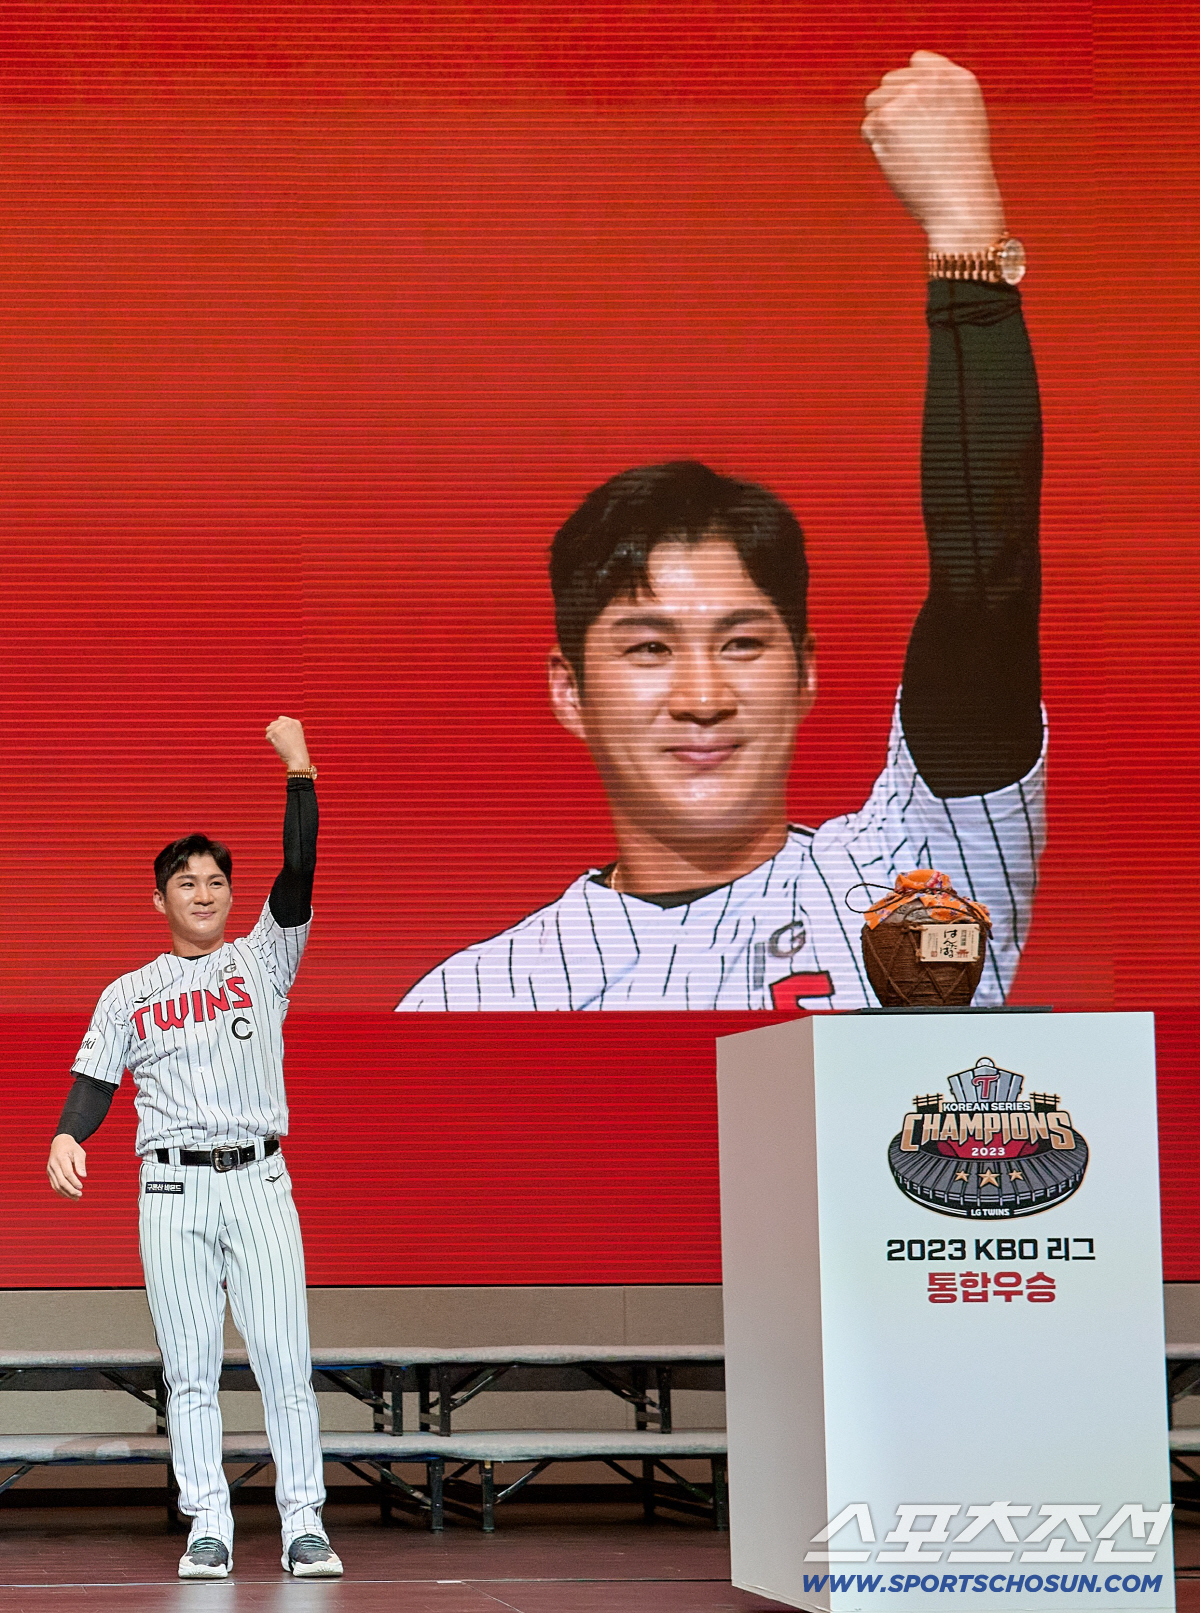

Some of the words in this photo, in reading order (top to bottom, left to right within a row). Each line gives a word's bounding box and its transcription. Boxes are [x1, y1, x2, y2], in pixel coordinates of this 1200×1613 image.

[130, 976, 253, 1040] TWINS
[231, 1016, 253, 1041] C
[943, 1102, 989, 1112] KOREAN
[991, 1101, 1031, 1112] SERIES
[900, 1111, 1076, 1152] CHAMPIONS
[971, 1147, 1006, 1157] 2023
[970, 1208, 981, 1216] LG
[982, 1208, 1010, 1216] TWINS
[887, 1239, 967, 1261] 2023
[975, 1239, 1038, 1261] KBO
[1047, 1238, 1096, 1261] 리그
[927, 1271, 1056, 1304] 통합우승
